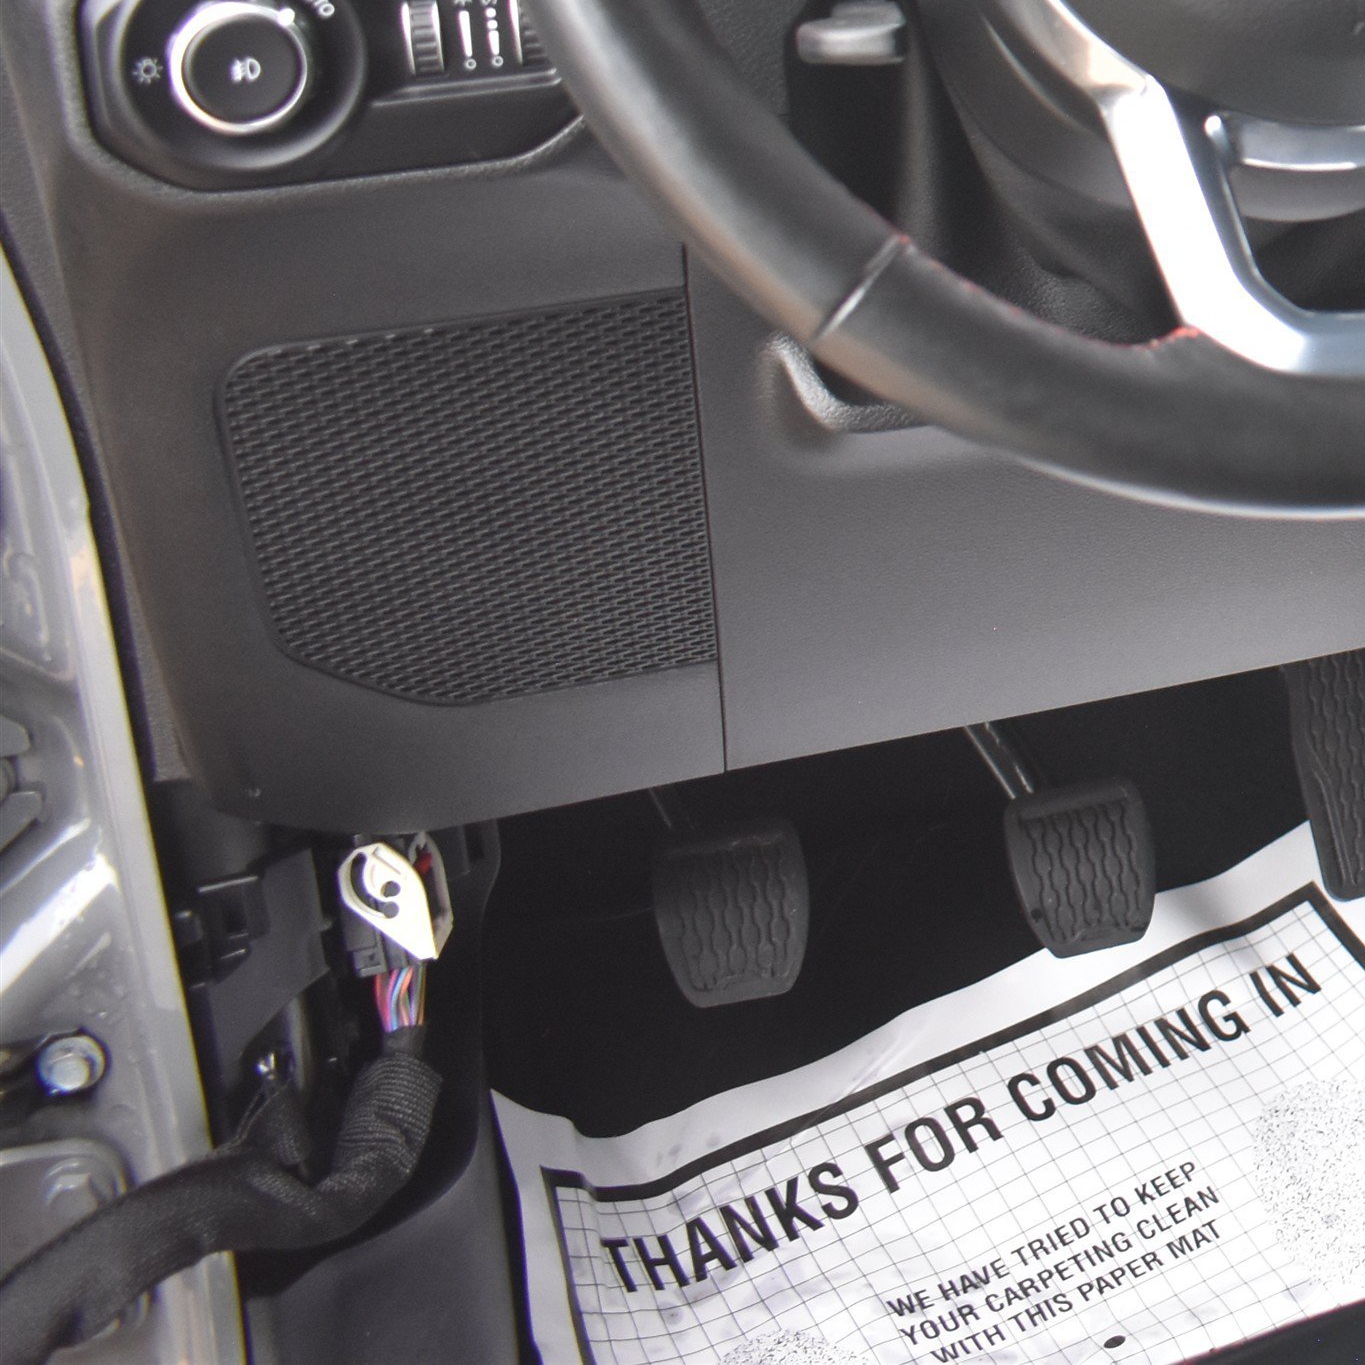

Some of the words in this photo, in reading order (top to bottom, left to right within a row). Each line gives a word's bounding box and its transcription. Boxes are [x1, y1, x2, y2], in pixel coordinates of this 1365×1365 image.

[601, 1161, 860, 1295] THANKS
[864, 1095, 1003, 1195] FOR
[1005, 989, 1252, 1124] COMING
[1249, 950, 1323, 1023] IN
[887, 1288, 934, 1317] WE
[938, 1259, 1010, 1302] HAVE
[1011, 1217, 1090, 1267] TRIED
[1093, 1196, 1131, 1225] TO
[1135, 1161, 1196, 1205] KEEP
[900, 1302, 979, 1346] YOUR
[985, 1231, 1132, 1313] CARPETING
[1137, 1185, 1220, 1239] CLEAN
[930, 1323, 1005, 1364] WITH
[1008, 1292, 1073, 1334] THIS
[1078, 1251, 1163, 1303] PAPER
[1166, 1218, 1221, 1260] MAT
